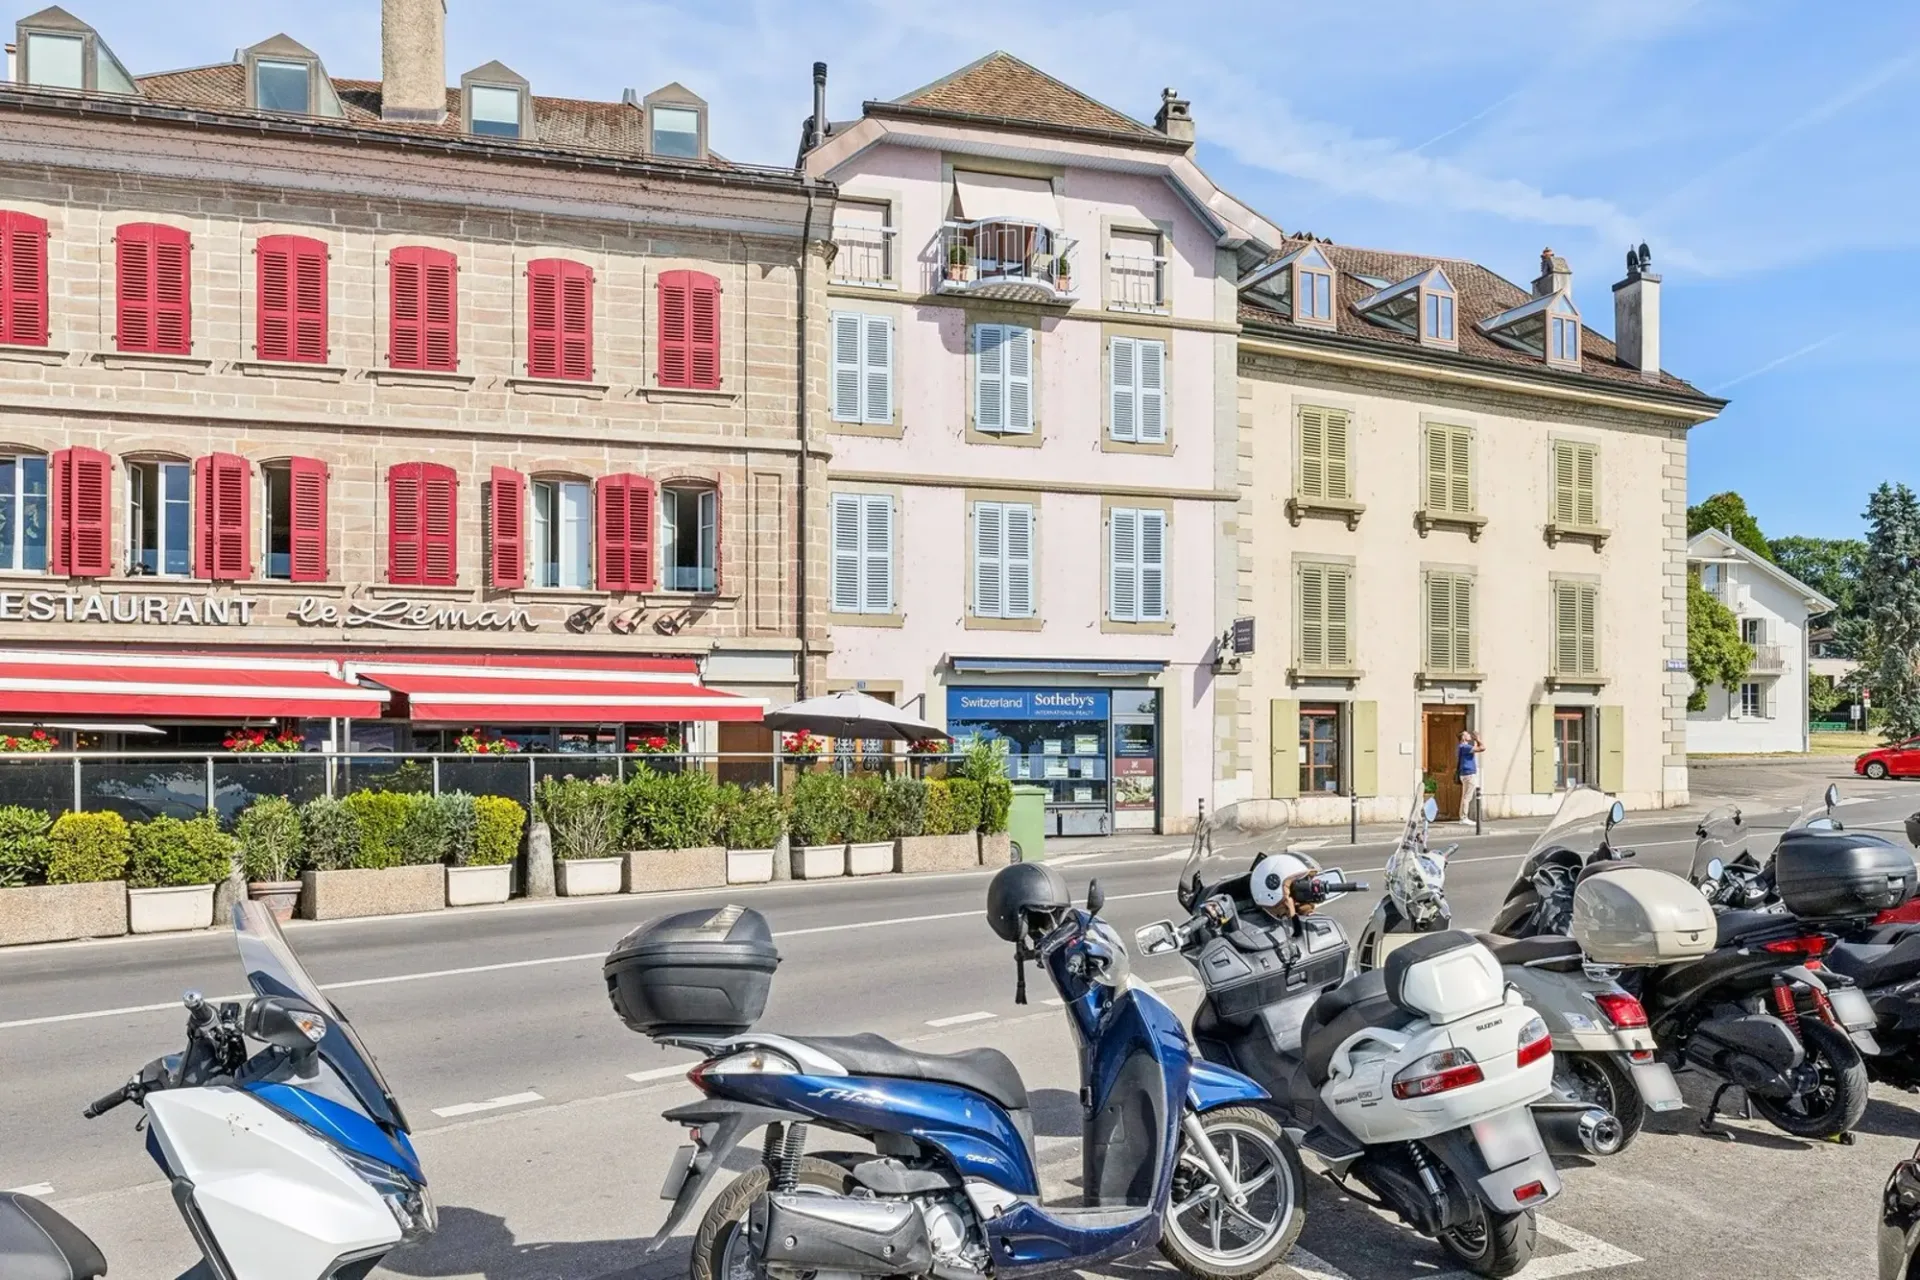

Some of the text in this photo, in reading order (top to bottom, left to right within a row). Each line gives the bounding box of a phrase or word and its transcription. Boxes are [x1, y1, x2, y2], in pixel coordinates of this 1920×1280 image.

[0, 591, 258, 624] ESTAURANT
[288, 596, 337, 623] le
[960, 696, 1023, 708] Switzerland
[1034, 692, 1094, 709] Sotheby's
[1475, 1018, 1503, 1032] SUZUKI
